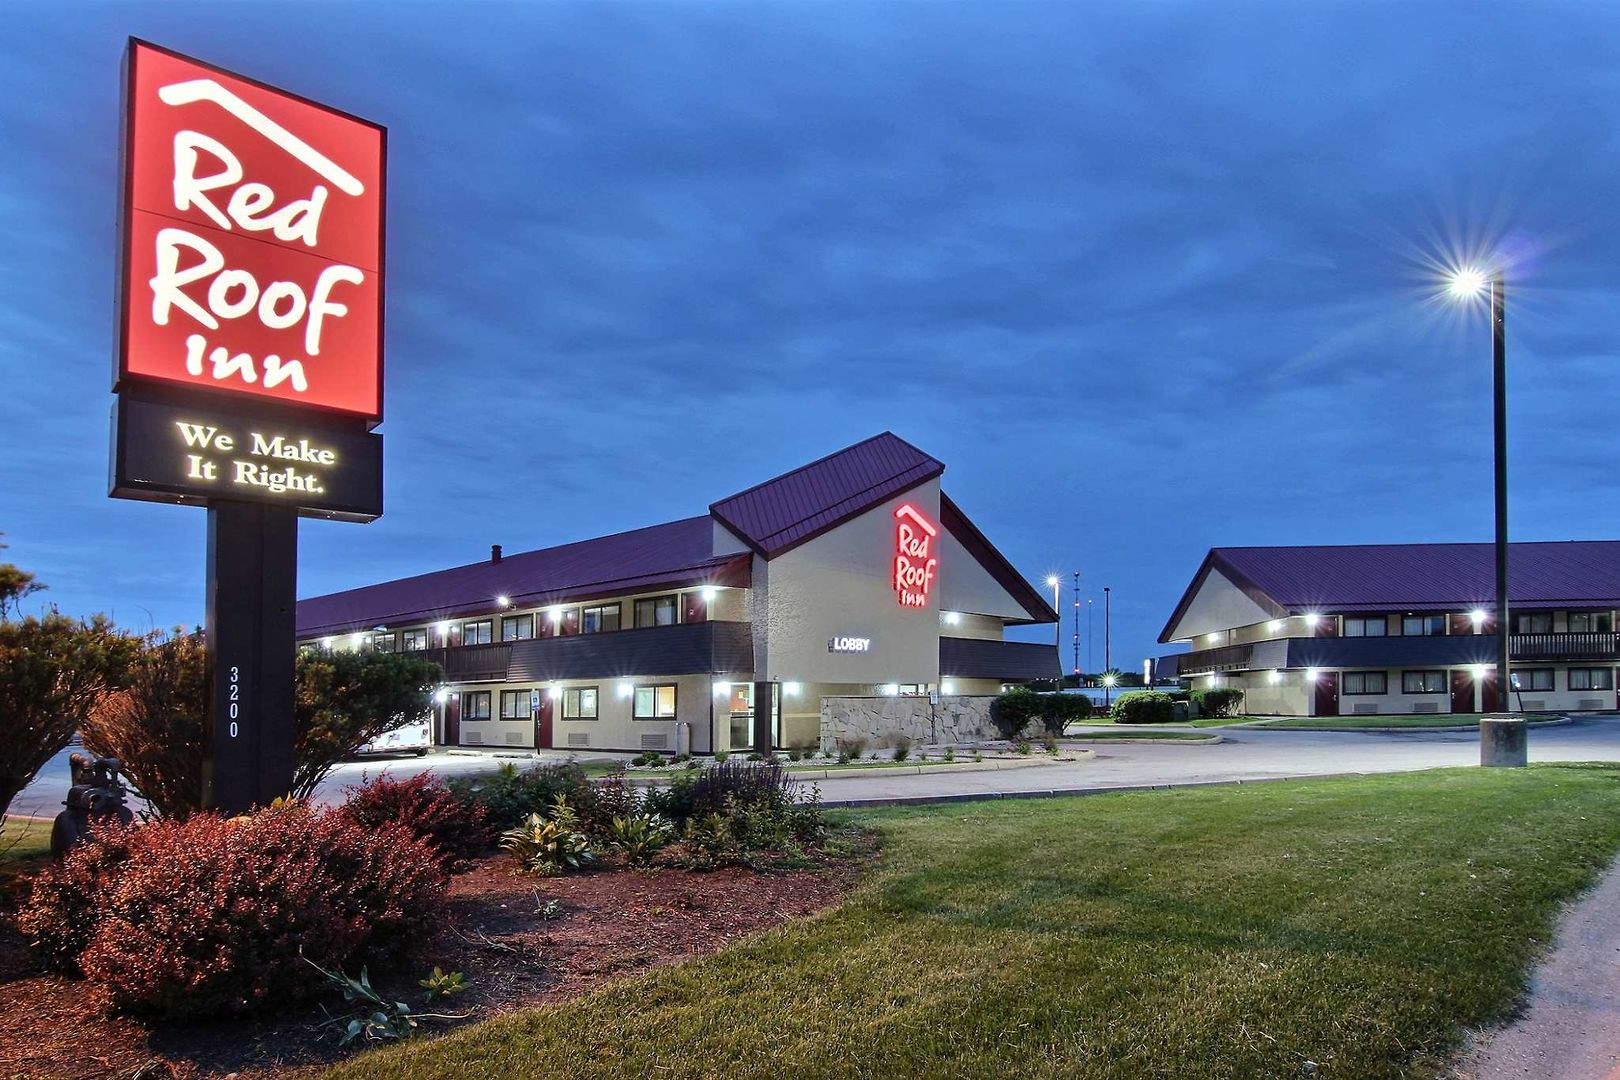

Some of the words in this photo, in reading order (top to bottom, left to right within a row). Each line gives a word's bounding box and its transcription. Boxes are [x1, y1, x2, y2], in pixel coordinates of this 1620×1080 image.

[173, 130, 328, 246] Red
[149, 228, 364, 355] Roof
[186, 334, 308, 392] Inn
[176, 422, 233, 451] We
[251, 433, 335, 465] Make
[187, 456, 217, 480] It
[234, 461, 324, 493] Right.
[899, 524, 929, 558] Red
[896, 556, 936, 593] Roof
[901, 590, 925, 606] Inn
[834, 637, 870, 651] LOBBY
[229, 666, 239, 738] 3200
